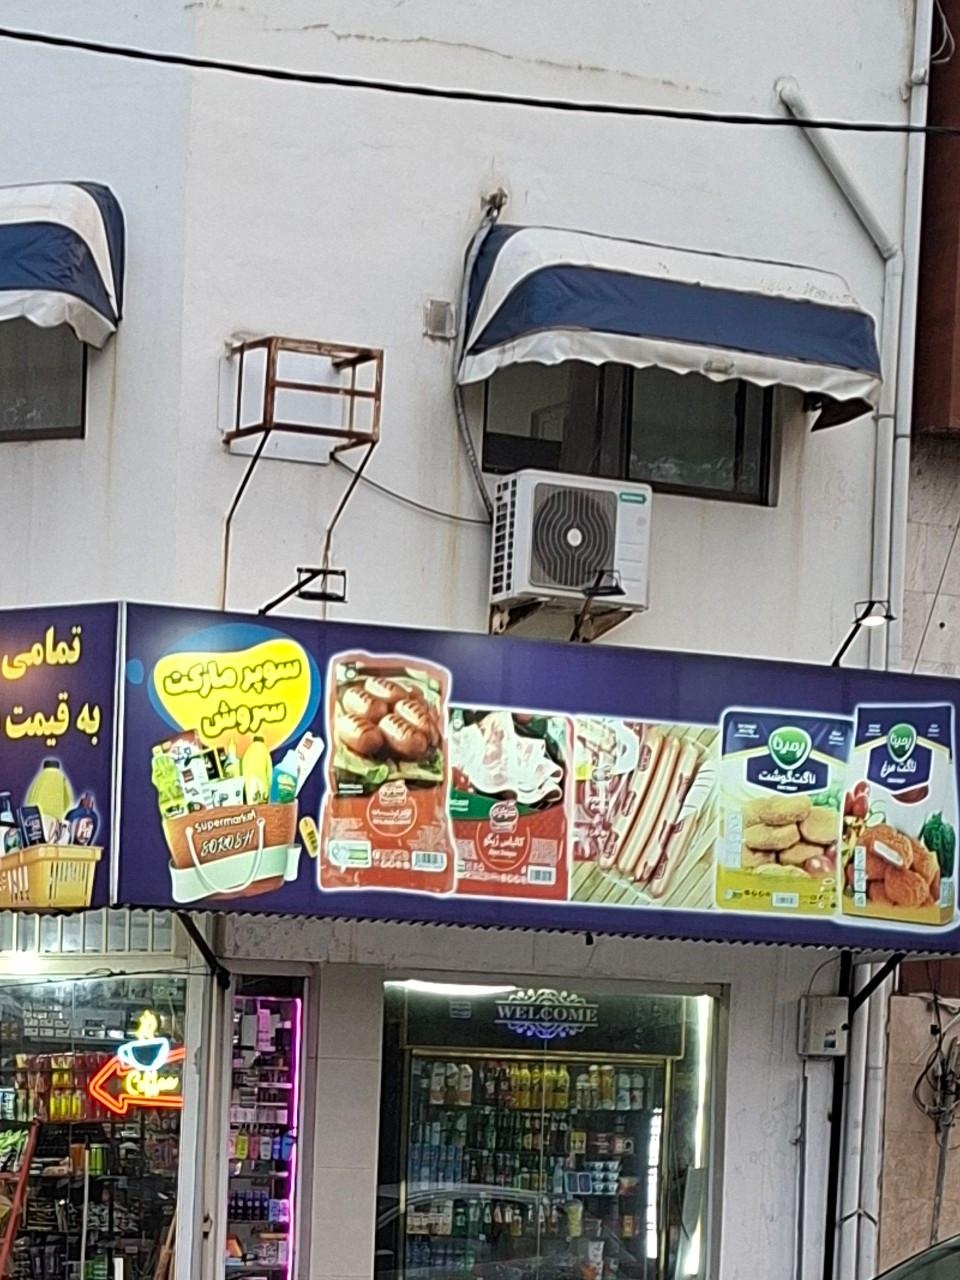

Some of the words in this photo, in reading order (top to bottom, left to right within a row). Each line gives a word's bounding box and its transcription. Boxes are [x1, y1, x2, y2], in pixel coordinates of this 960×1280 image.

[2, 626, 82, 679] تمامی
[163, 660, 238, 698] مارکت
[5, 692, 70, 746] قیمت
[76, 702, 100, 746] به
[200, 700, 287, 738] سروش
[200, 829, 255, 857] SOROSH
[496, 1005, 598, 1022] WELCOME
